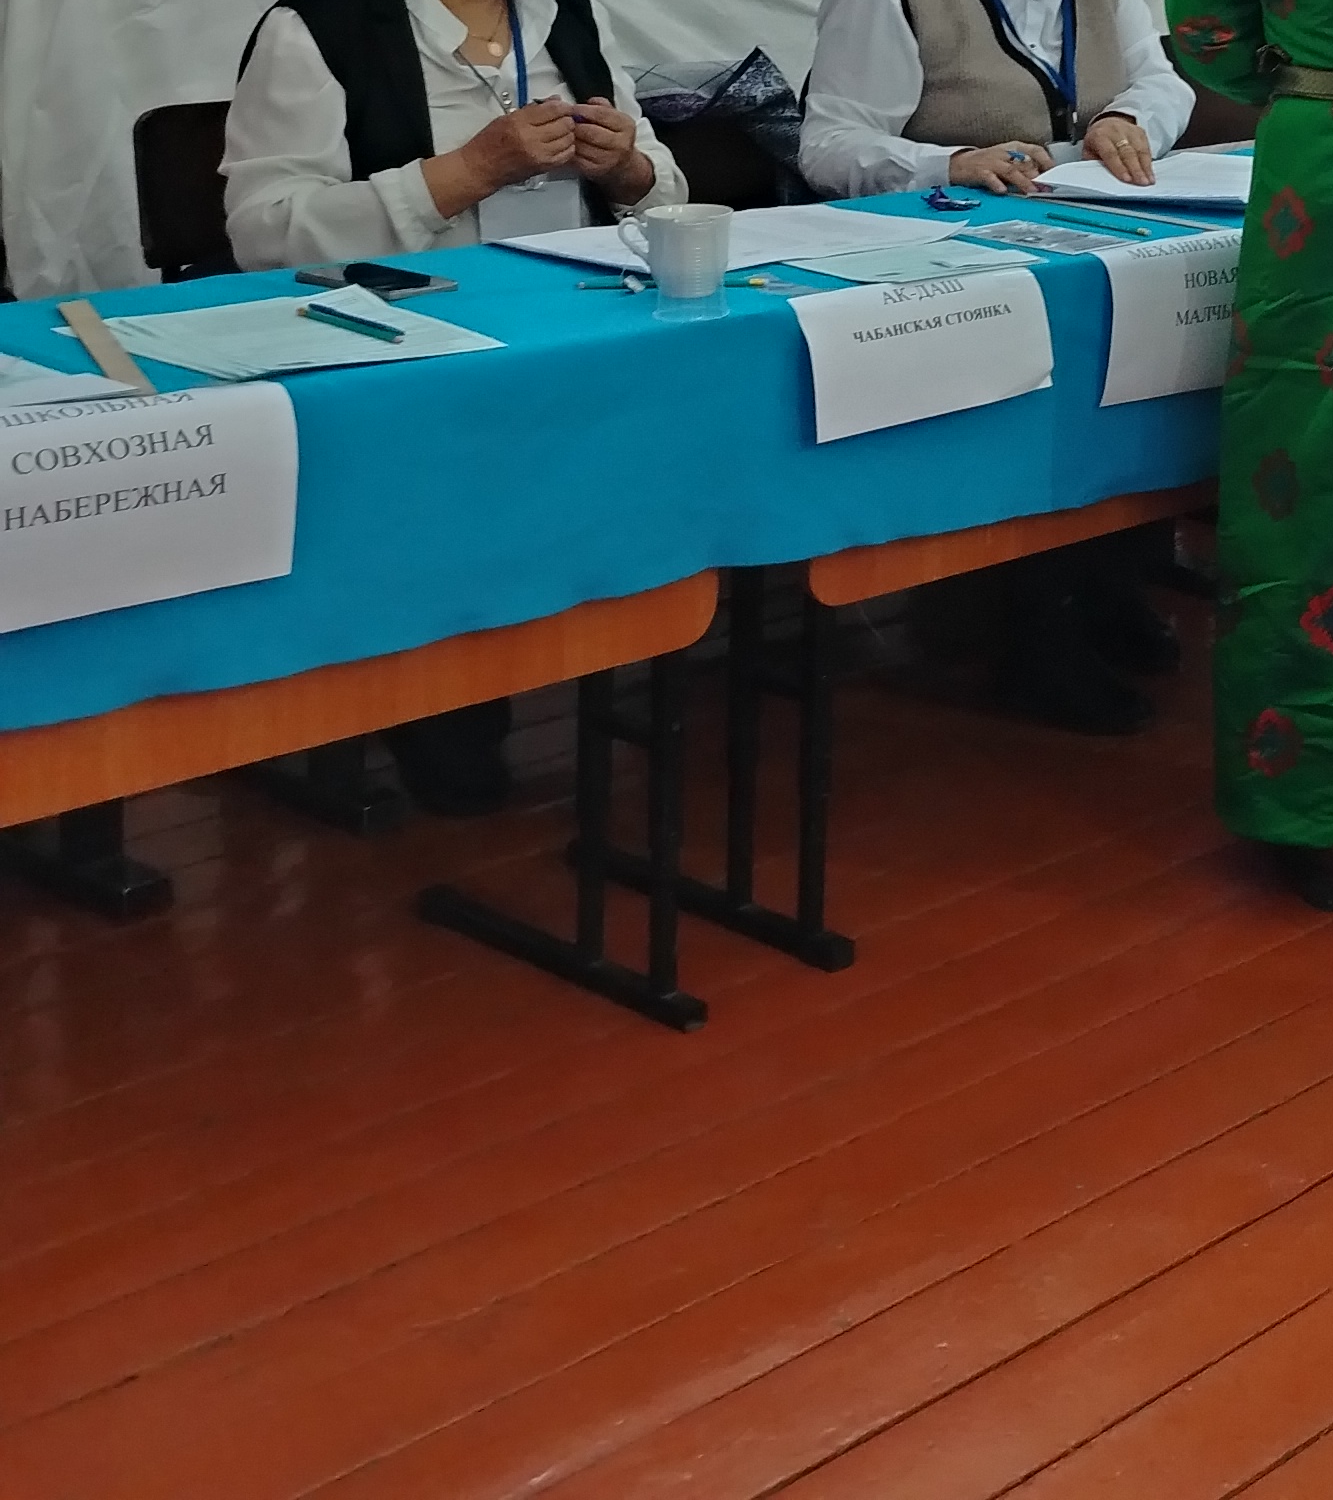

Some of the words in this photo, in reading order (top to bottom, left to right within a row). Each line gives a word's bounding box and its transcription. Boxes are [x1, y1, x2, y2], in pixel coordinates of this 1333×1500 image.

[1127, 233, 1242, 259] МЕХАНИЗАТО
[882, 278, 965, 306] АК-ДАШ
[1184, 267, 1239, 289] НОВАЯ
[852, 315, 943, 345] ЧАБАНСКАЯ
[945, 303, 1011, 327] СТОЯНКА
[1176, 302, 1236, 327] МАЛЧЫ
[0, 392, 195, 428] ШКОЛЬНАЯ
[11, 423, 216, 475] СОВХОЗНАЯ
[4, 472, 228, 531] НАБЕРЕЖНАЯ
